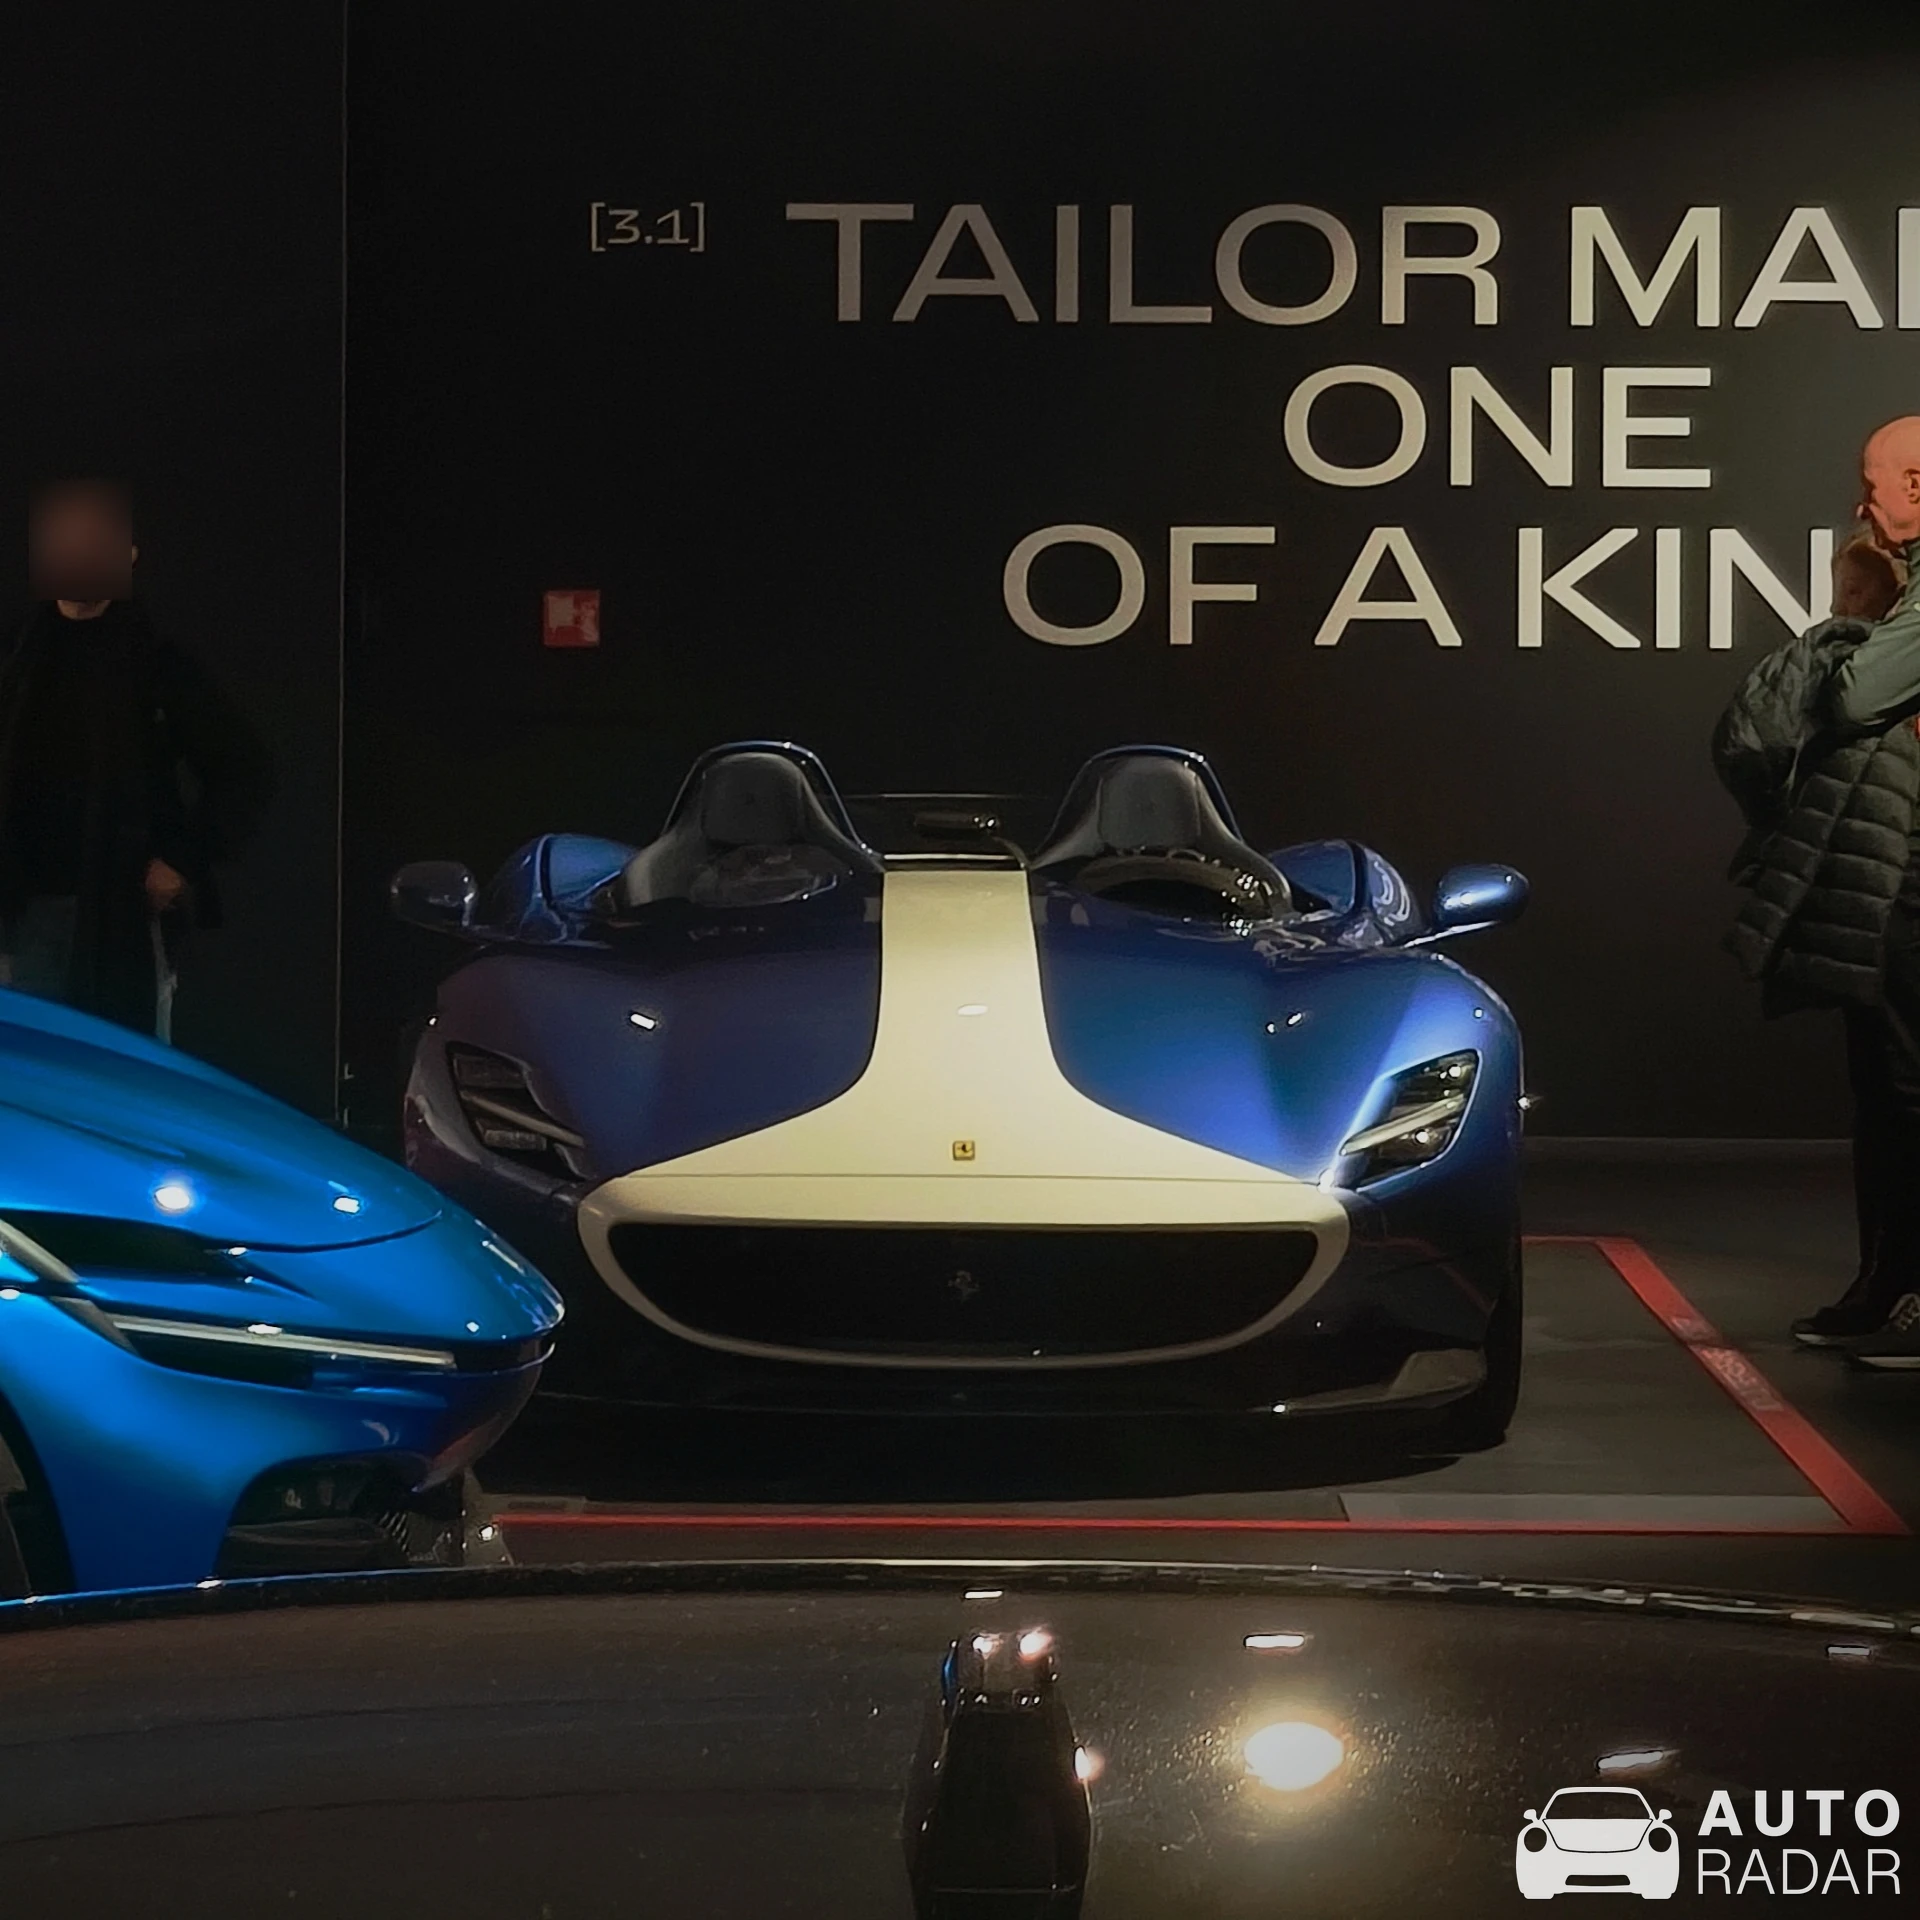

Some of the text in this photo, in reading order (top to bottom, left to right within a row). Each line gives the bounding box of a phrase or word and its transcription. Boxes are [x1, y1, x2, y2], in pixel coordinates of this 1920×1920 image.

[590, 202, 706, 253] [3.1]
[786, 203, 1920, 329] TAILOR MA
[1284, 365, 1712, 488] ONE
[1003, 524, 1276, 646] OF
[1314, 526, 1463, 647] A
